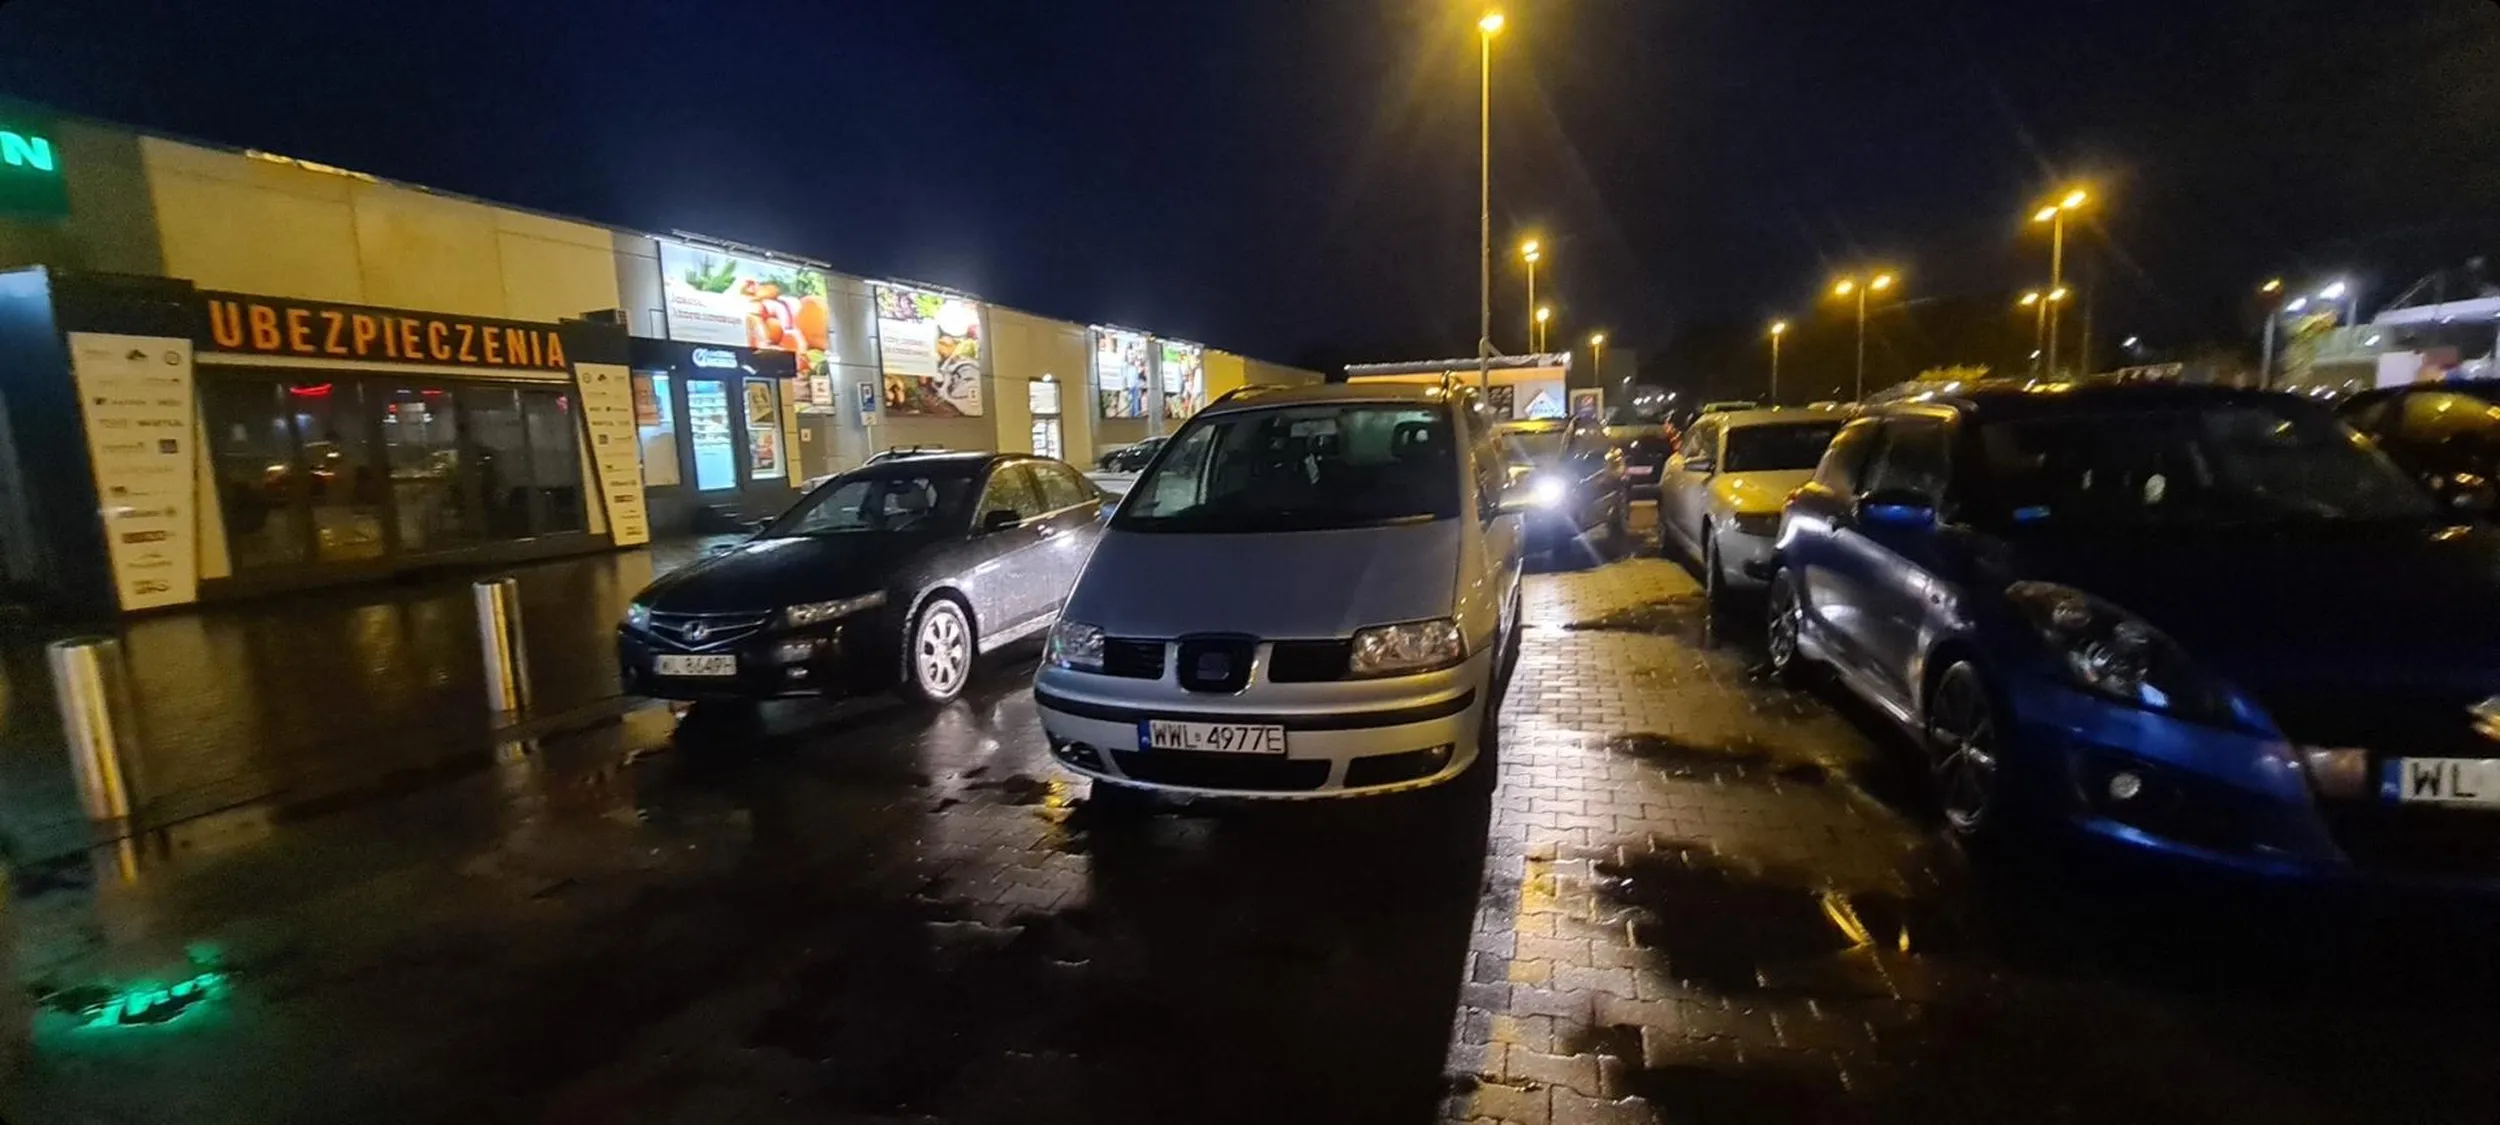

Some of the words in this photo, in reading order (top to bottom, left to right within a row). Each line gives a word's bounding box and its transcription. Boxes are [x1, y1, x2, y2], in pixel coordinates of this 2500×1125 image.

[0, 131, 53, 171] N
[209, 300, 566, 369] UBEZPIECZENIA
[1152, 723, 1197, 749] WWL
[1207, 726, 1282, 751] 4977E
[2411, 761, 2477, 797] WL
